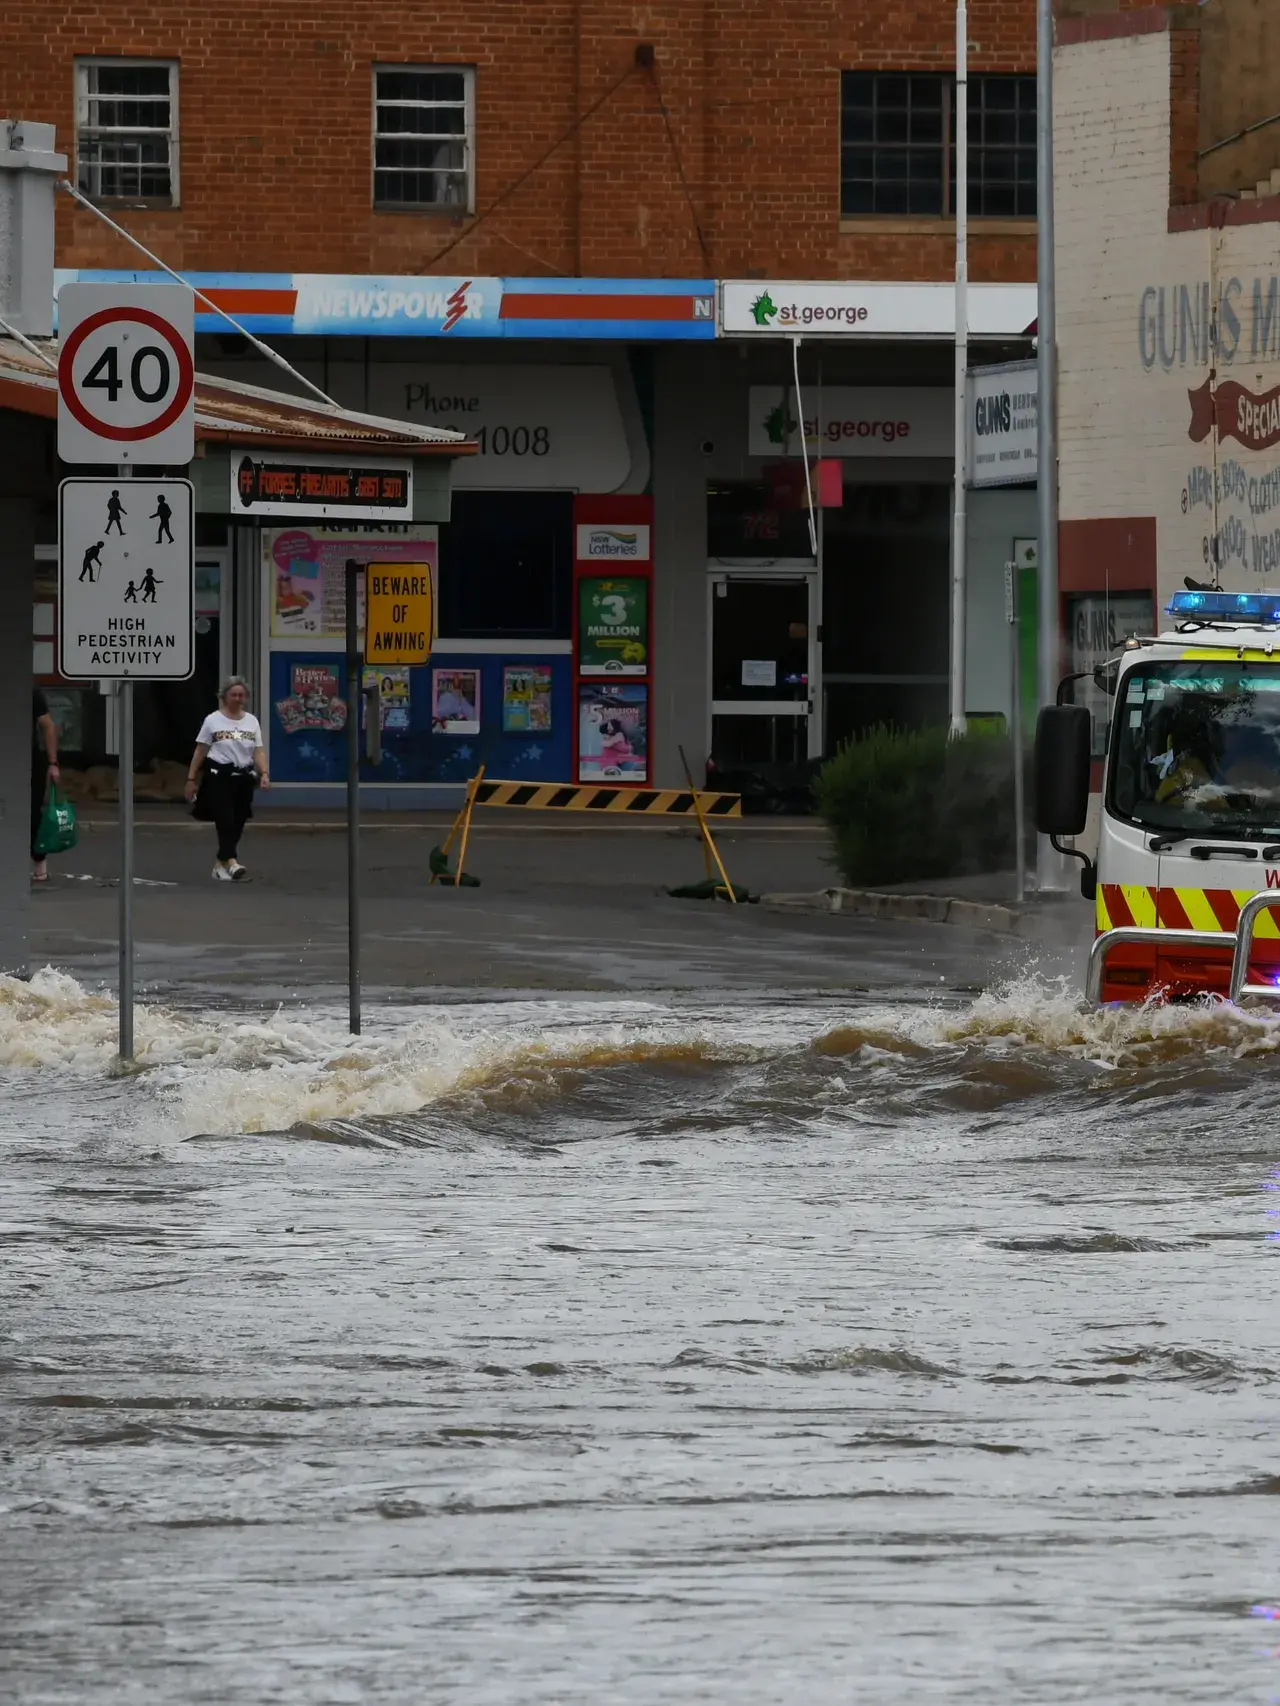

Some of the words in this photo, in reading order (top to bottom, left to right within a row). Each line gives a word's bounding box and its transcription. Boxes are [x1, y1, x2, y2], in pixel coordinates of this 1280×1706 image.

[780, 304, 868, 324] st.george
[81, 345, 171, 403] 40
[404, 382, 480, 414] Phone
[474, 425, 550, 456] 1008
[588, 543, 637, 555] Lotteries
[373, 577, 427, 596] BEWARE
[392, 604, 408, 623] OF
[108, 617, 145, 631] HIGH
[587, 625, 640, 637] MILLION
[78, 634, 175, 648] PEDESTRIAN
[373, 632, 426, 651] AWNING
[91, 652, 162, 664] ACTIVITY
